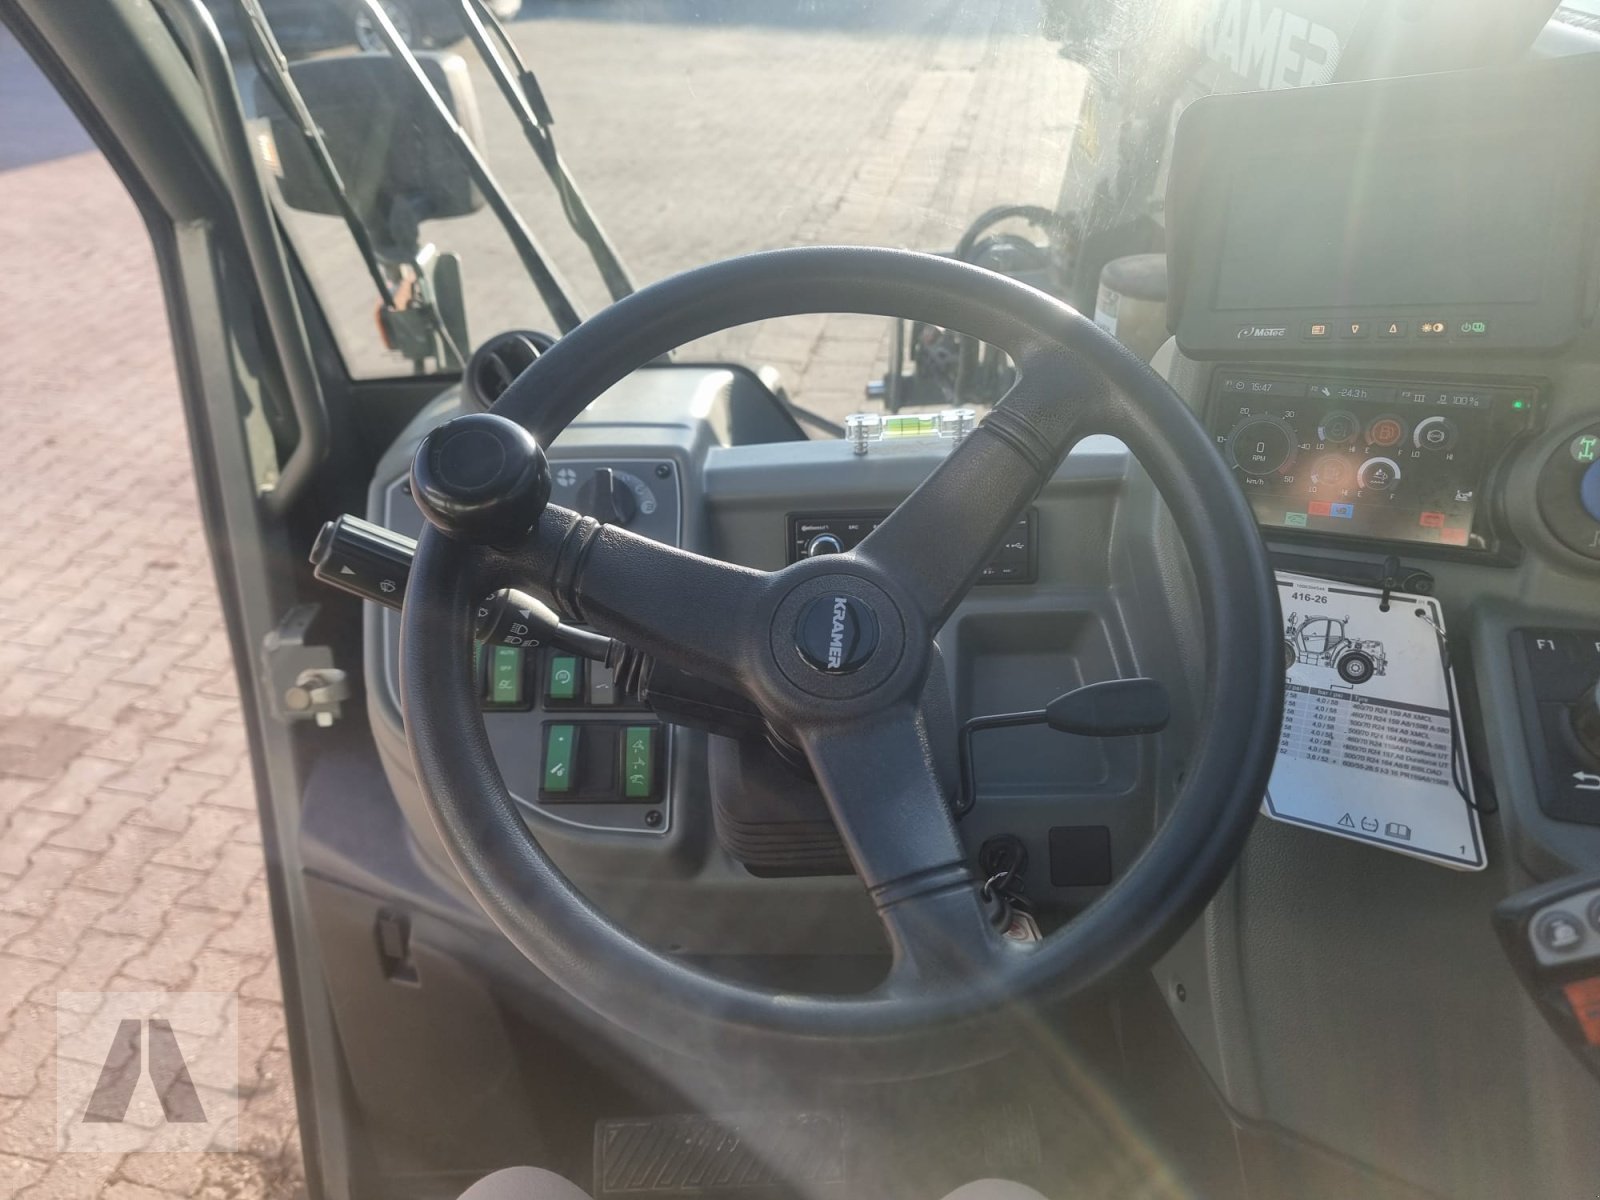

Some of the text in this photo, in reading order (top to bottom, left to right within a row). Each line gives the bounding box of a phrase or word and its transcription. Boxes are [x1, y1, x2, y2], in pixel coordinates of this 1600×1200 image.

[1252, 382, 1272, 392] 15:47
[1256, 442, 1264, 452] 0
[1292, 592, 1328, 604] 416-26
[828, 596, 847, 669] KRAMER
[1536, 639, 1556, 650] F1
[1459, 844, 1466, 855] 1
